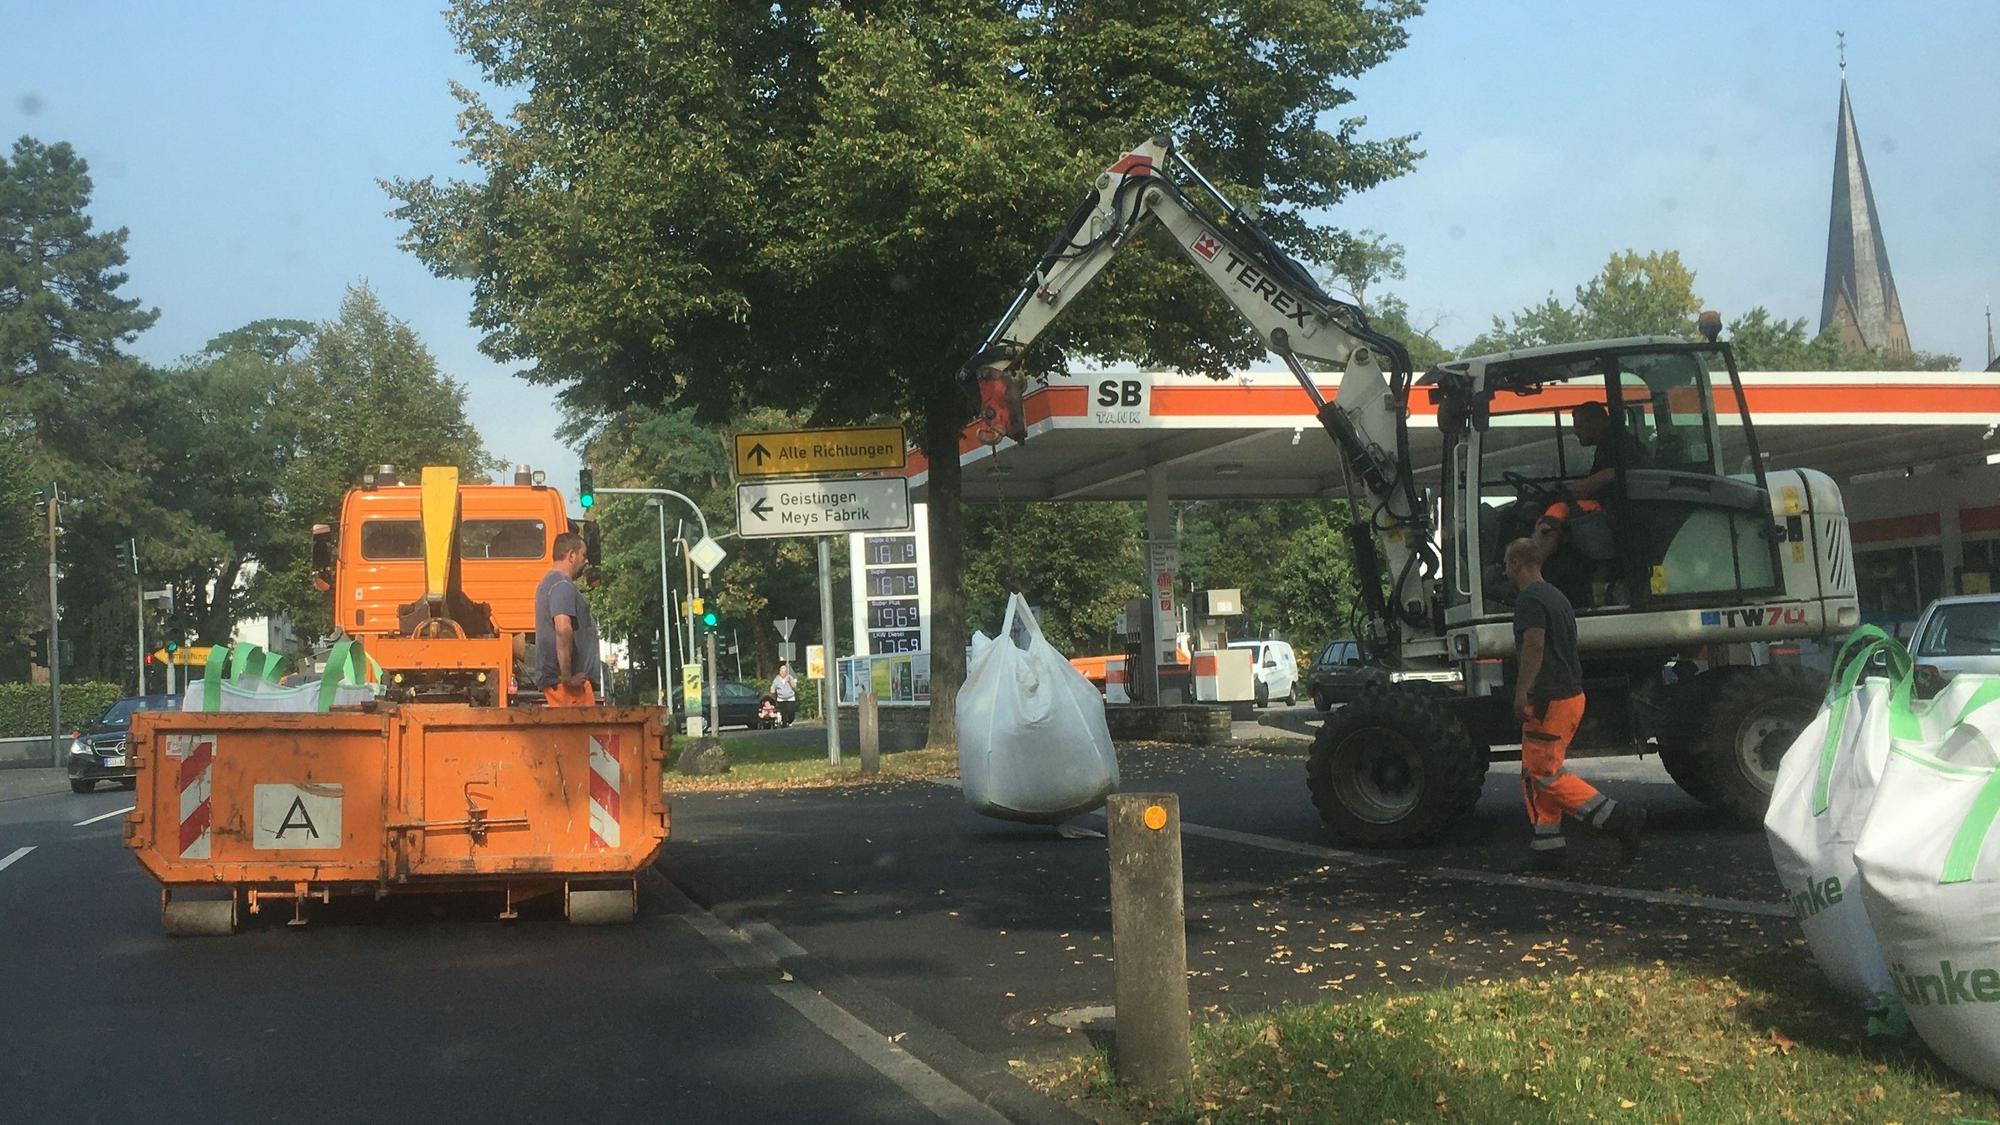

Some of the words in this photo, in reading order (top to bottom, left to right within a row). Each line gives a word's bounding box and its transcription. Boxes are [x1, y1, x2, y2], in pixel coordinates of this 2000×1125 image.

[1224, 252, 1313, 328] TEREX
[1097, 380, 1142, 407] SB
[1096, 411, 1141, 424] TANK
[779, 447, 807, 460] Alle
[813, 443, 894, 459] Richtungen
[780, 491, 857, 508] Geistingen
[781, 511, 819, 526] Meys
[825, 507, 870, 522] Fabrik
[275, 794, 320, 839] A
